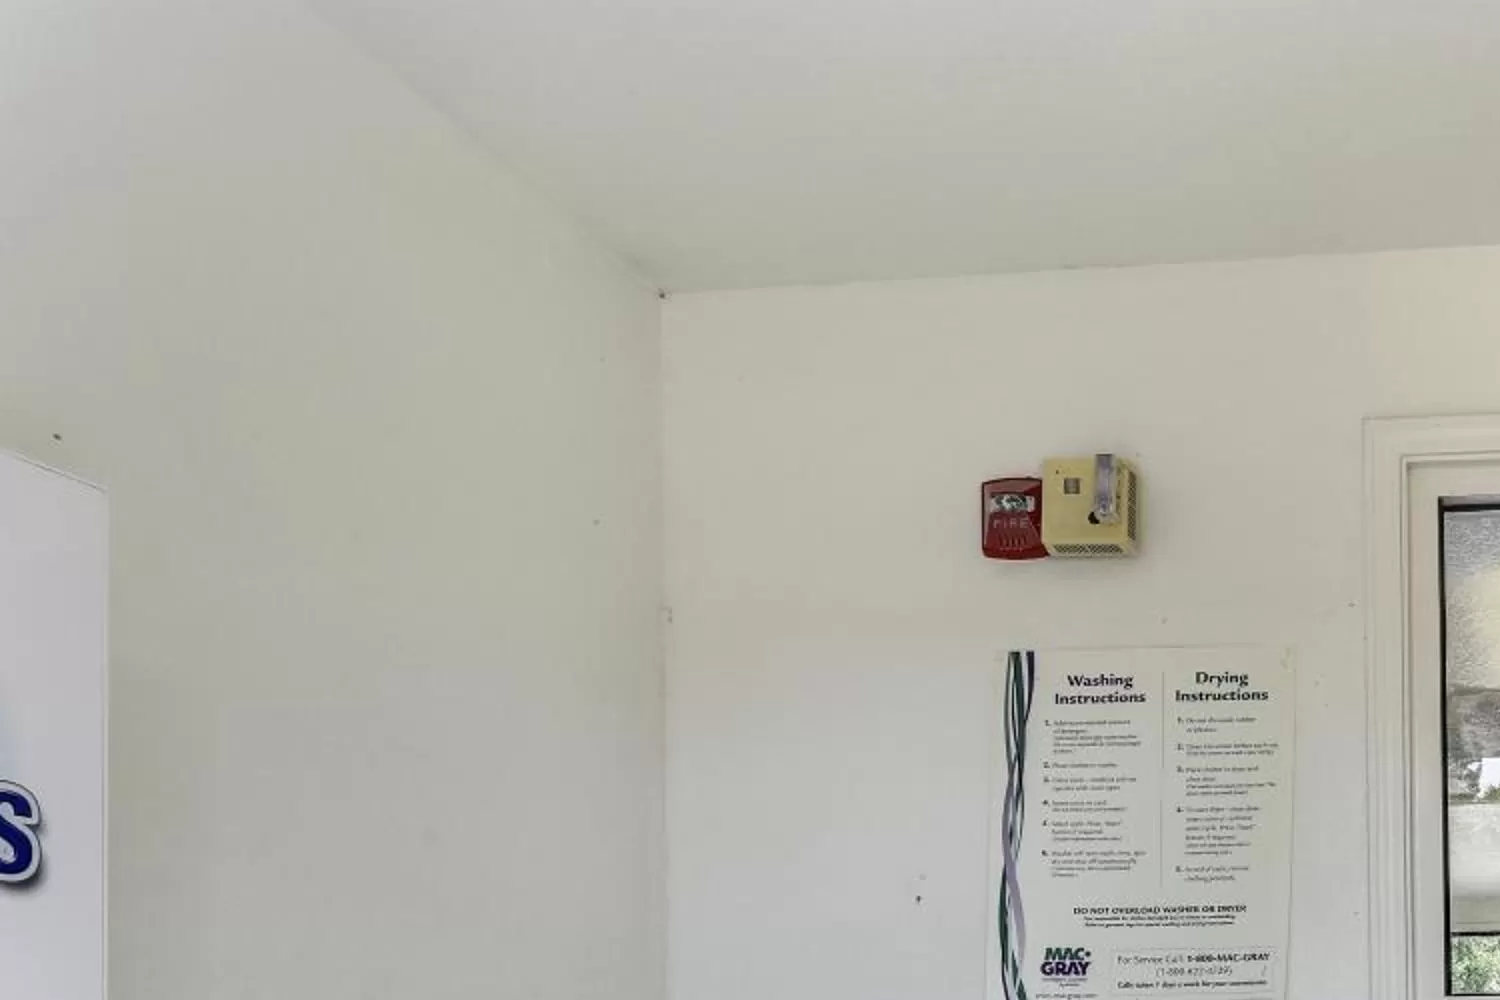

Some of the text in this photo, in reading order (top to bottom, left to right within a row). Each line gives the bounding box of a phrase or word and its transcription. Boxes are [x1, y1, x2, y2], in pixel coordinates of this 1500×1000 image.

[1067, 673, 1133, 688] Washing
[1195, 671, 1249, 687] Drying
[1054, 691, 1147, 705] Instructions
[1175, 689, 1269, 702] Instructions
[1073, 907, 1088, 915] DO
[1090, 907, 1110, 915] NOT
[1111, 906, 1161, 915] OVERLOAD
[1117, 955, 1132, 965] For
[1133, 955, 1163, 964] Service
[1040, 961, 1092, 976] GRAY
